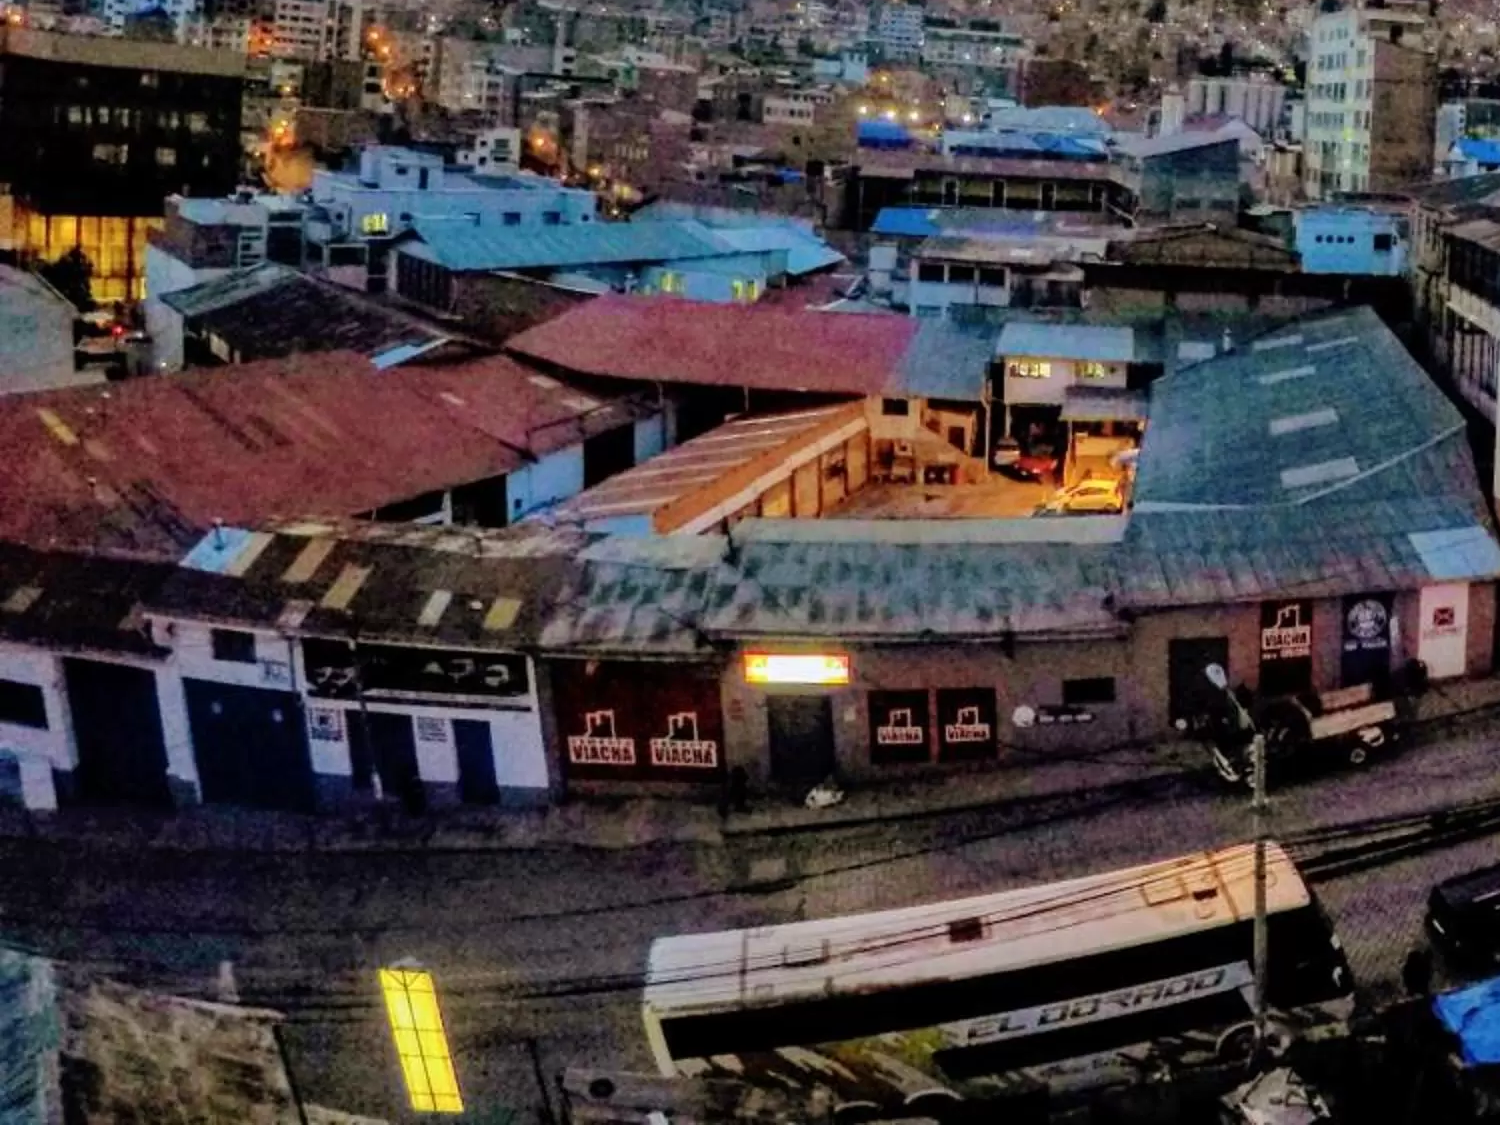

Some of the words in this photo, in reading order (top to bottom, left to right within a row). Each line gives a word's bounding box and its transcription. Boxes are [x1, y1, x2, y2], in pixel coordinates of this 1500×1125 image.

[572, 744, 633, 761] VIACHA
[654, 746, 714, 764] VIACHA
[967, 1016, 1029, 1038] EL
[1037, 968, 1227, 1027] DORADO
